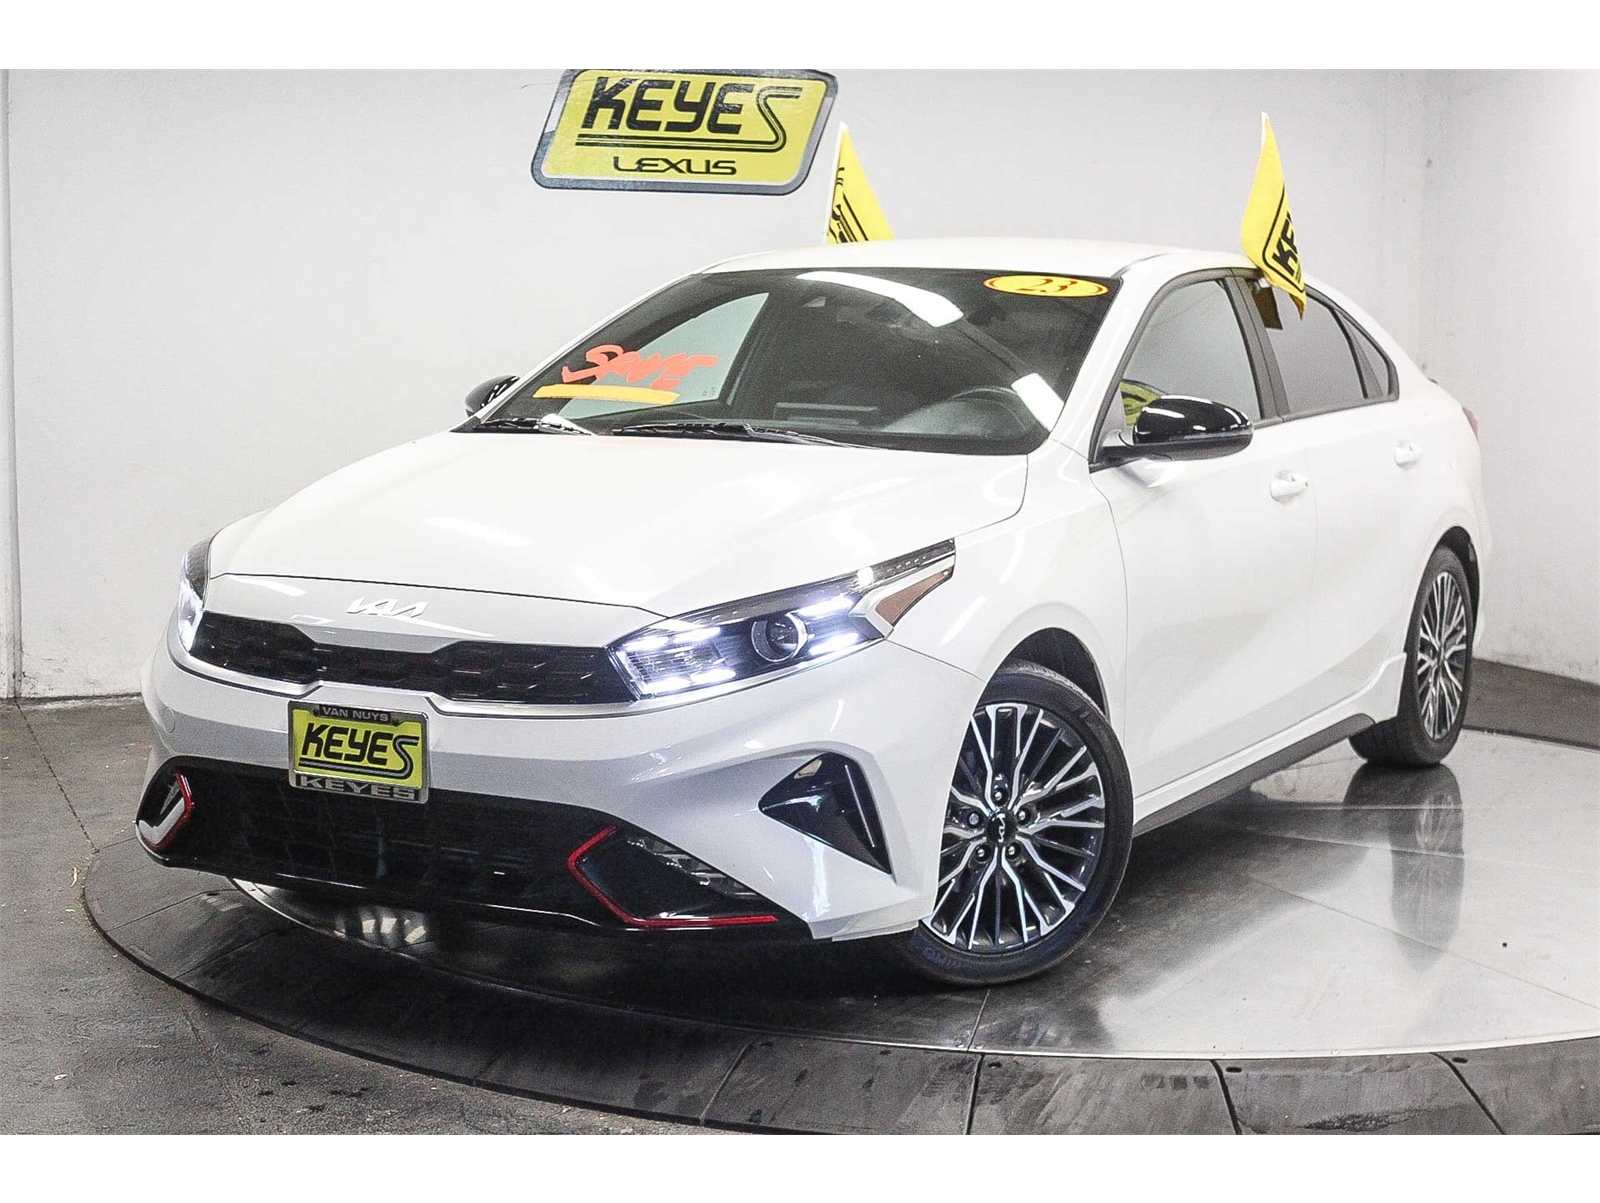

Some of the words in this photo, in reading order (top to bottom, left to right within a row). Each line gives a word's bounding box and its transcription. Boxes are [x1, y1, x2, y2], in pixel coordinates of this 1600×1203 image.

[577, 76, 803, 153] KEYES
[612, 156, 737, 176] LEXUS
[1272, 211, 1298, 277] KE
[321, 705, 348, 718] VAN
[352, 709, 389, 722] NUYS
[299, 722, 420, 779] KEYES
[301, 776, 416, 800] KEYES
